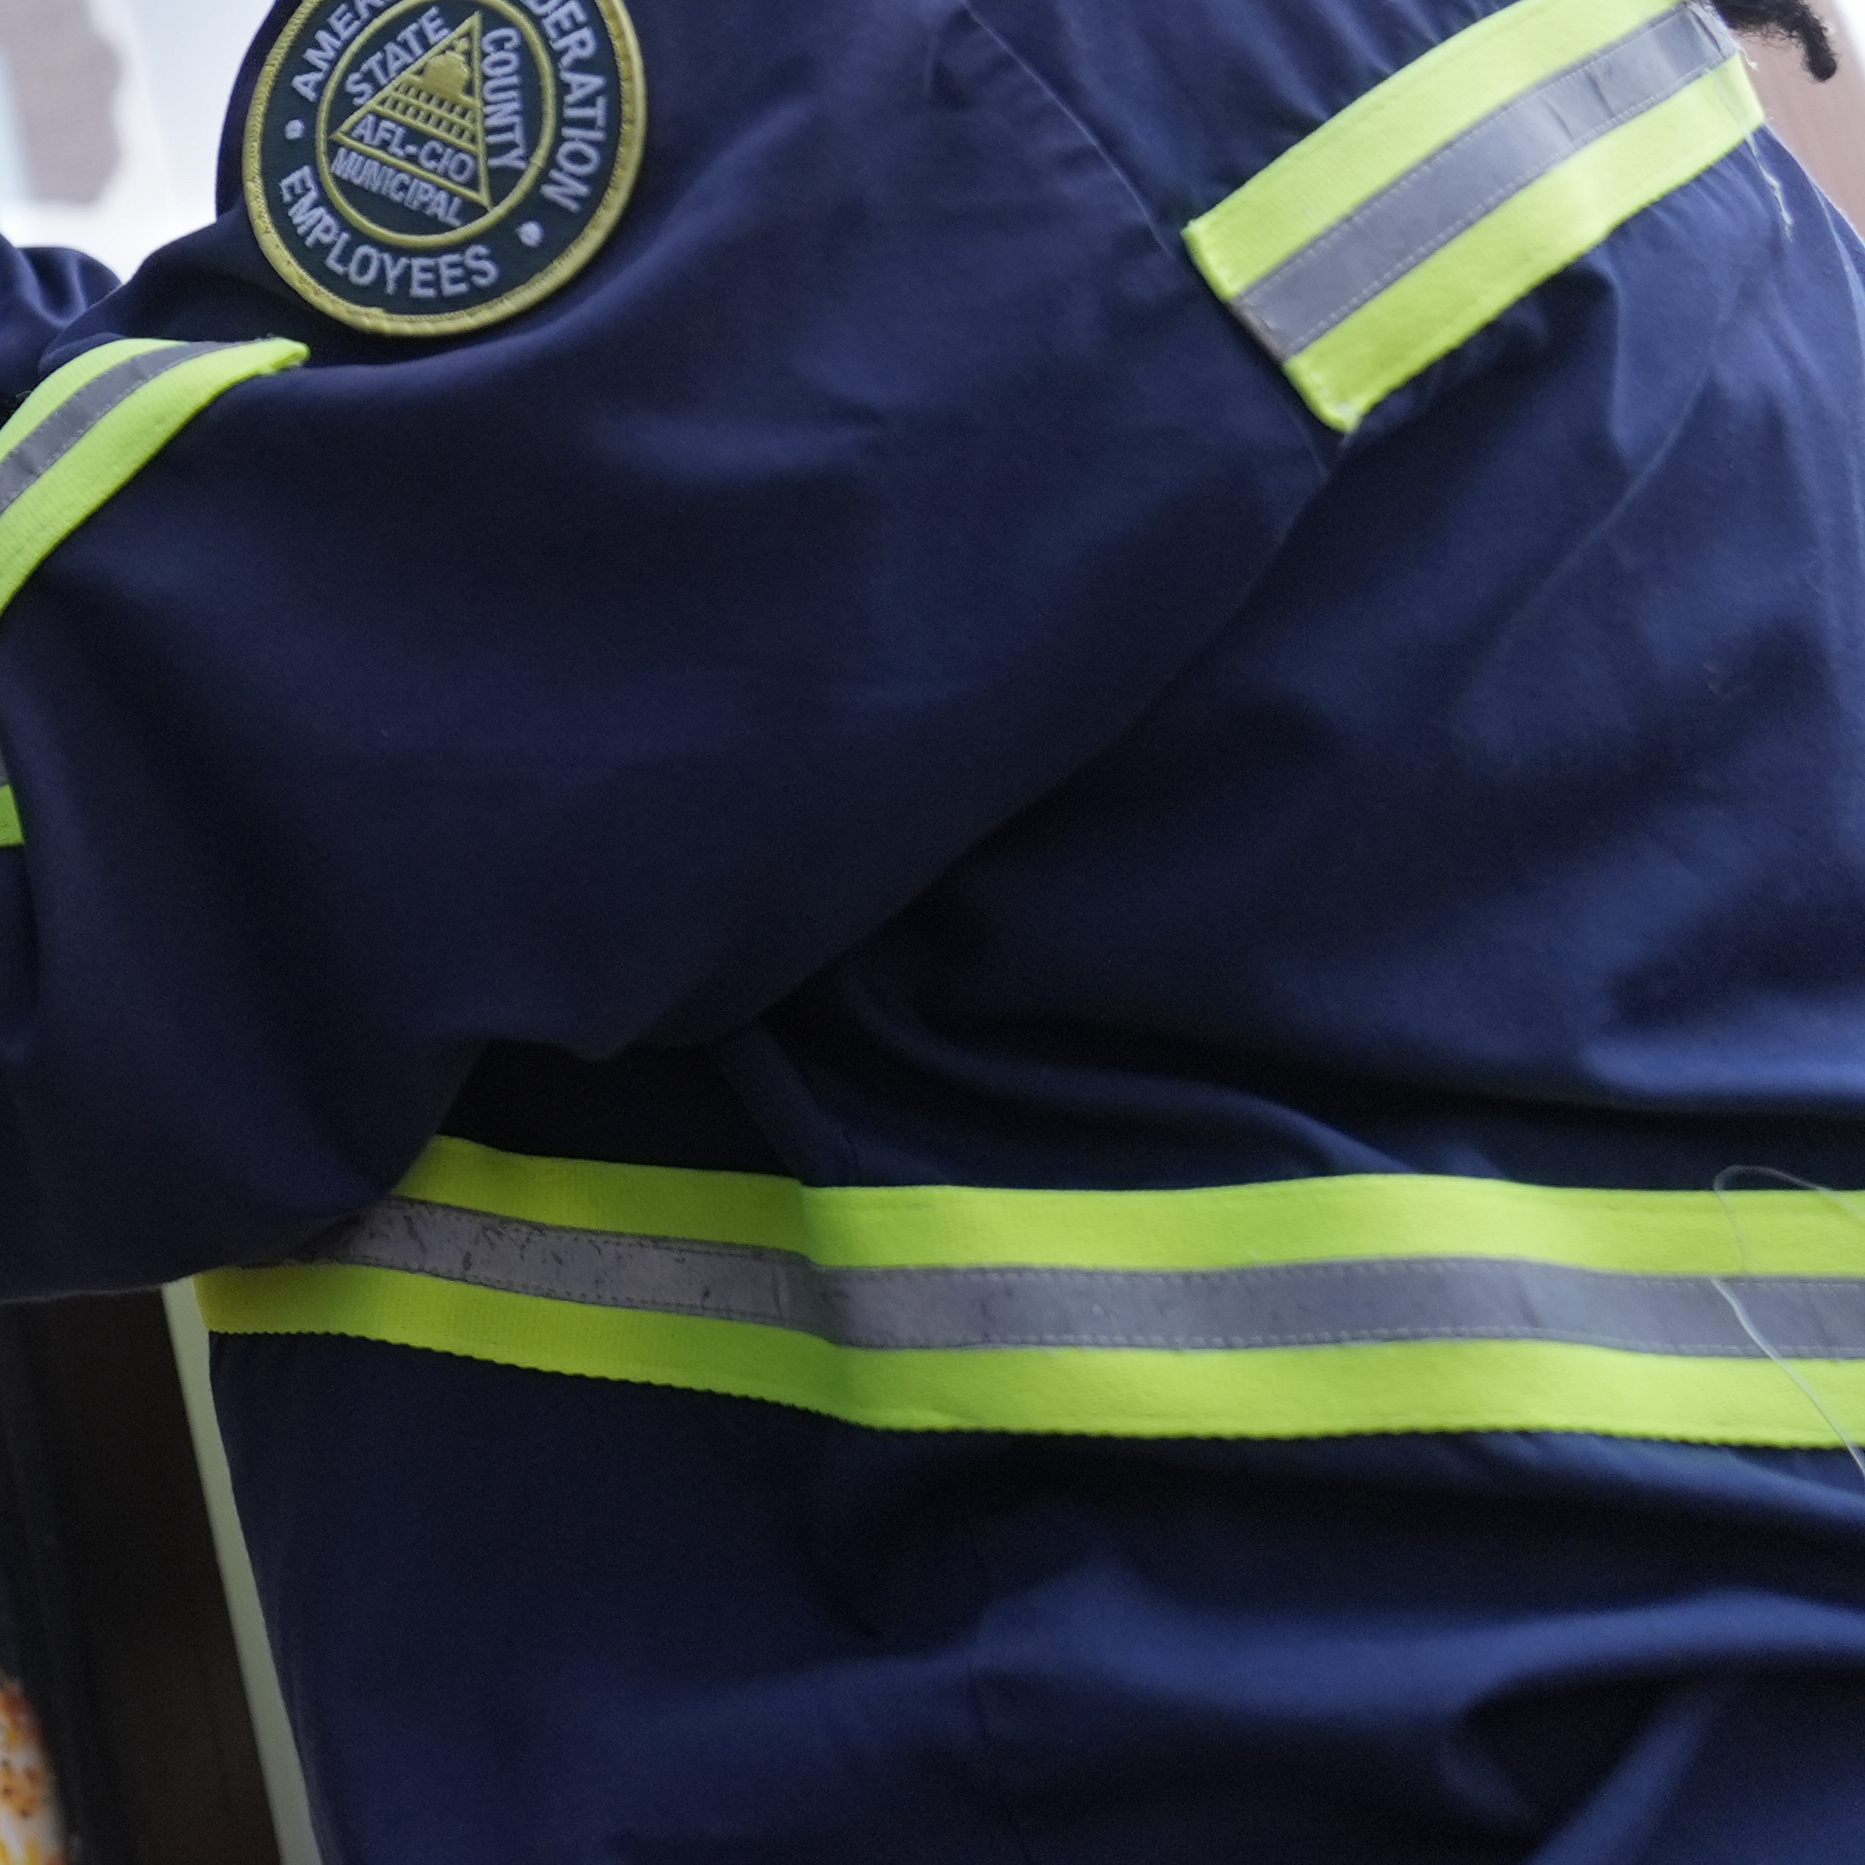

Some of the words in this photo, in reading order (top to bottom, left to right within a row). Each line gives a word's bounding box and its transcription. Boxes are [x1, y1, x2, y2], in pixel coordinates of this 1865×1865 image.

[345, 6, 451, 106] STATE
[482, 27, 528, 170] COUNTY
[331, 147, 465, 226] MUNICIPAL
[351, 115, 475, 183] AFL-CIO
[279, 165, 498, 298] EMPLOYEES
